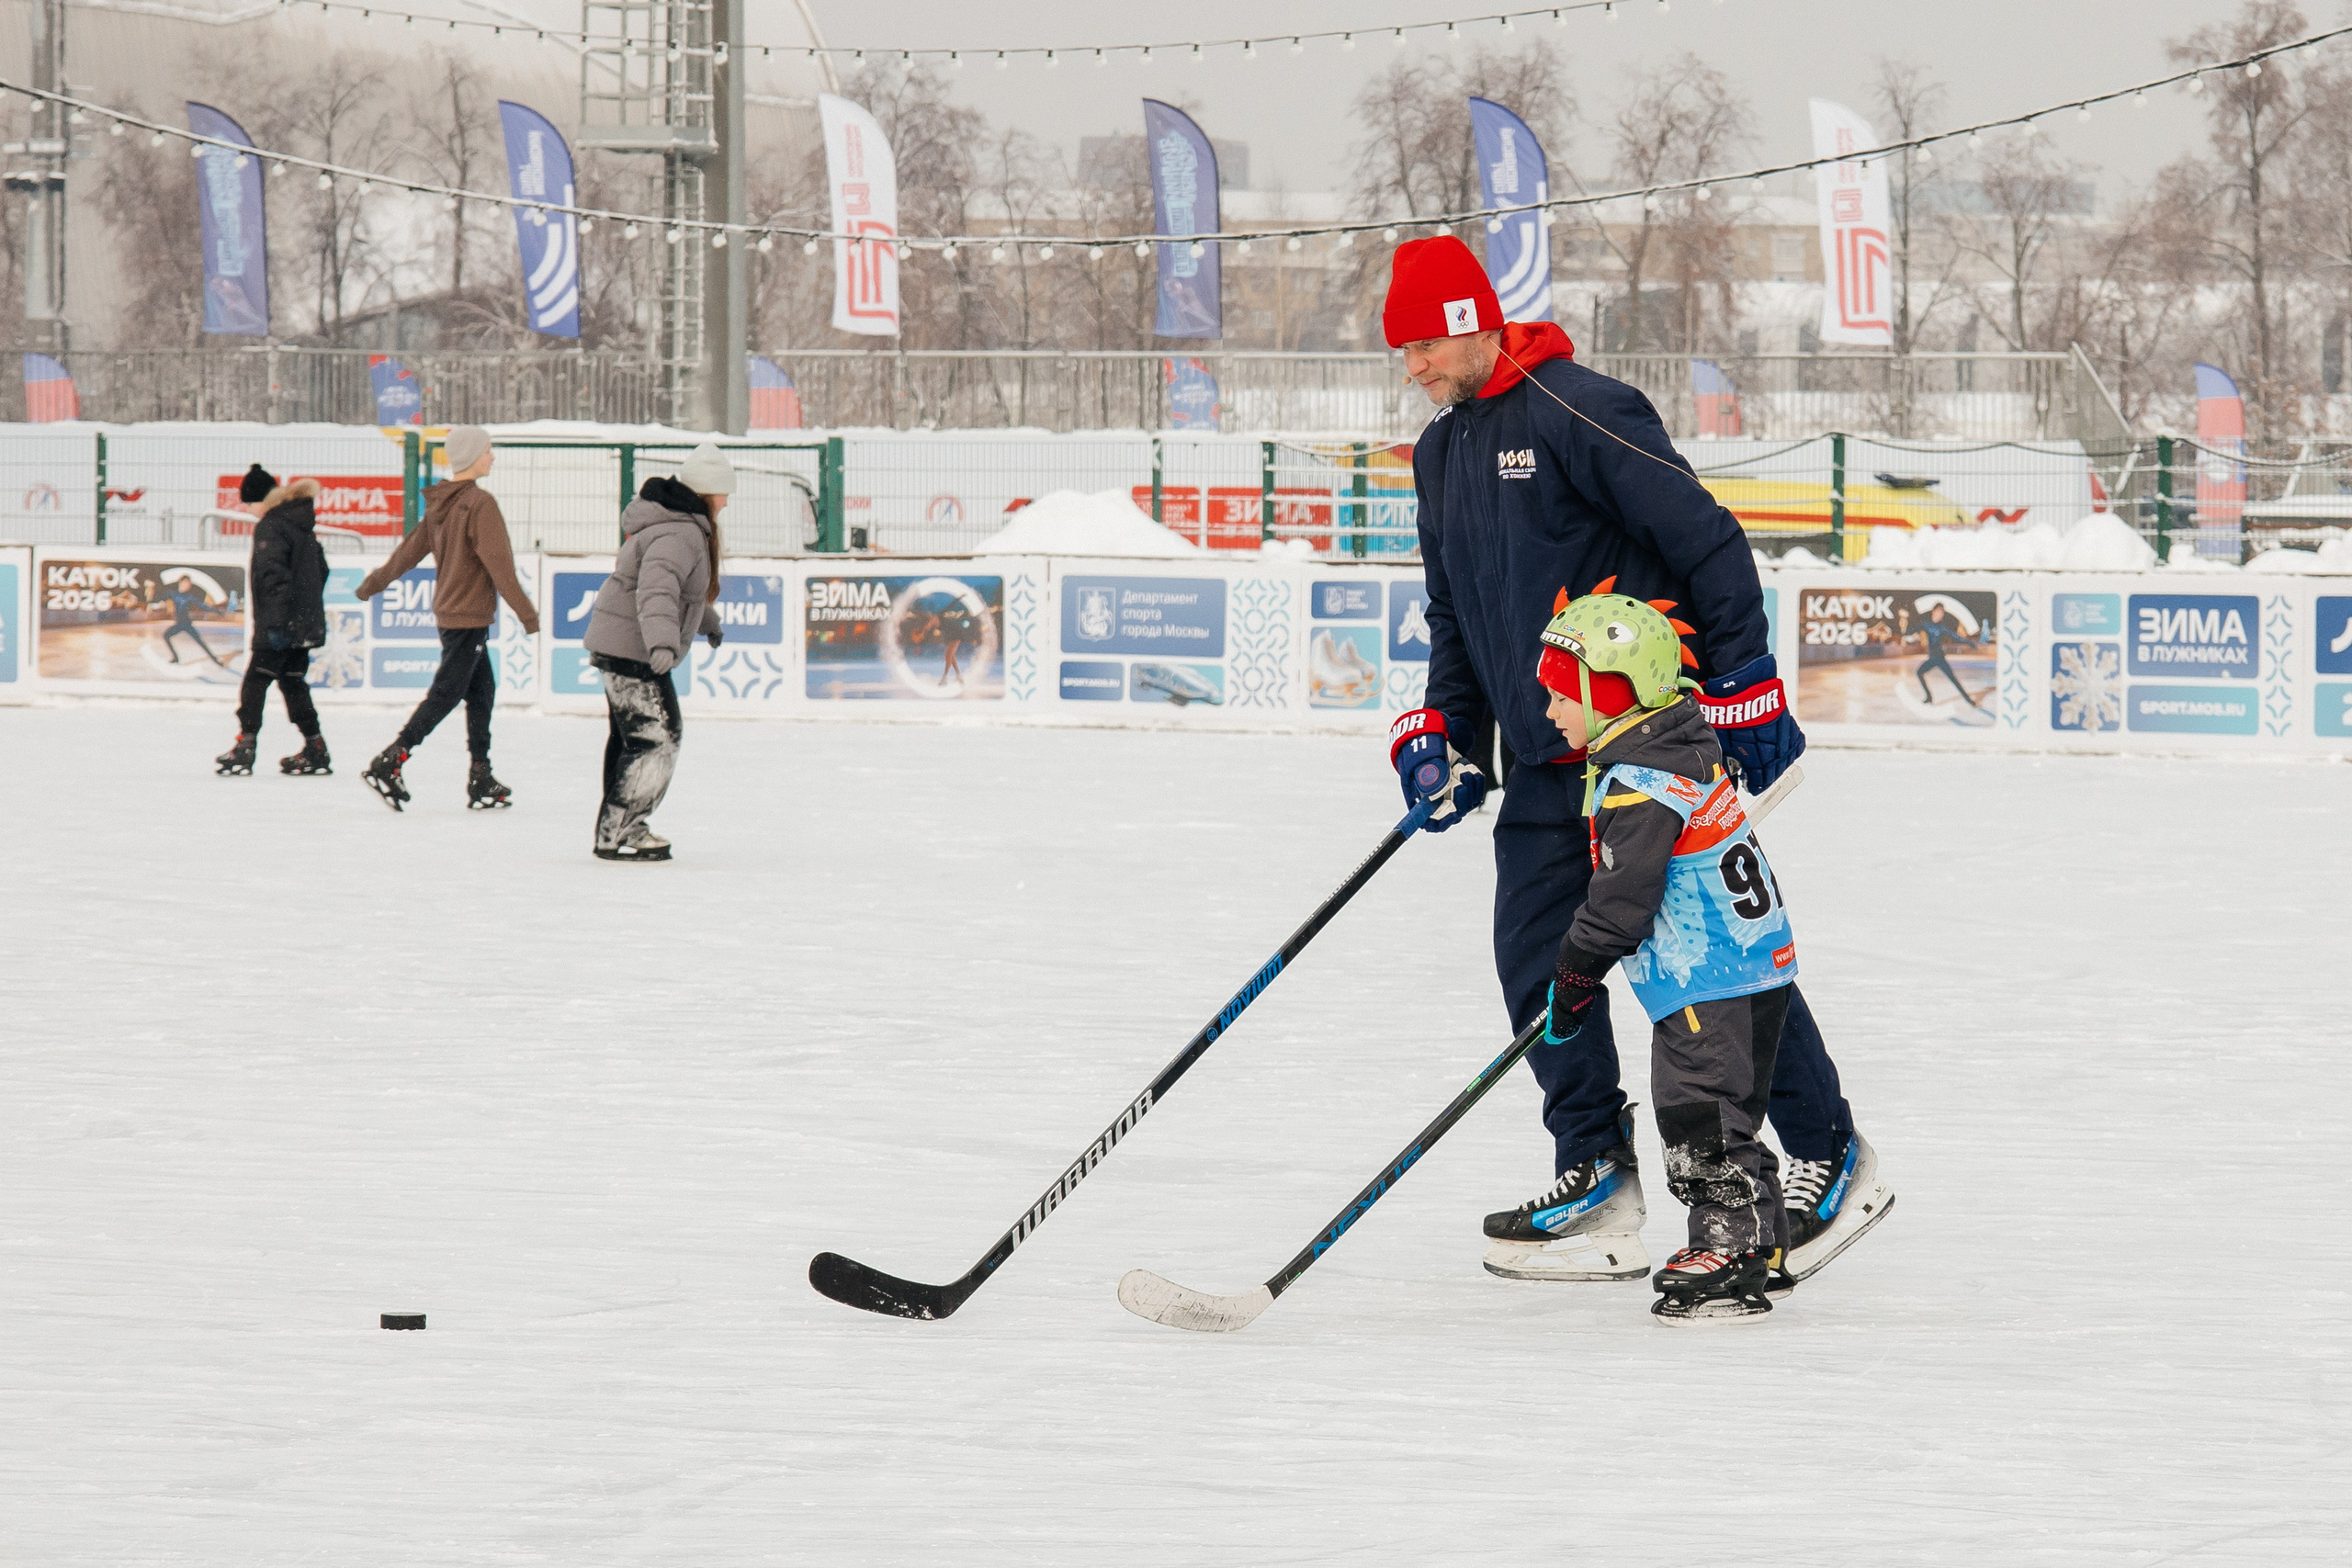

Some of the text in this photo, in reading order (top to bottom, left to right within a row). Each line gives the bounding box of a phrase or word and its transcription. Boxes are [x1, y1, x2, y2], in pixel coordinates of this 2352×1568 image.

[315, 488, 388, 510] ИМА
[48, 566, 140, 590] КАТОК
[47, 589, 112, 612] 2026
[382, 579, 436, 611] ЗИ
[810, 581, 891, 607] ЗИМА
[1122, 590, 1199, 606] Департамент
[810, 607, 891, 621] В ЛУЖНИКАХ
[1122, 608, 1162, 622] спорта
[1805, 595, 1894, 619] КАТОК
[1121, 624, 1210, 638] города Москвы
[1805, 621, 1869, 646] 2026
[2138, 607, 2248, 645] ЗИМА
[2137, 645, 2249, 665] В ЛУЖНИКАХ
[1699, 688, 1781, 725] ARRIOR
[2139, 700, 2246, 717] SPORT.MOS.RU
[1410, 735, 1428, 753] 11
[1219, 953, 1283, 1032] NOVIUM
[1012, 1089, 1155, 1251] WARRIOR
